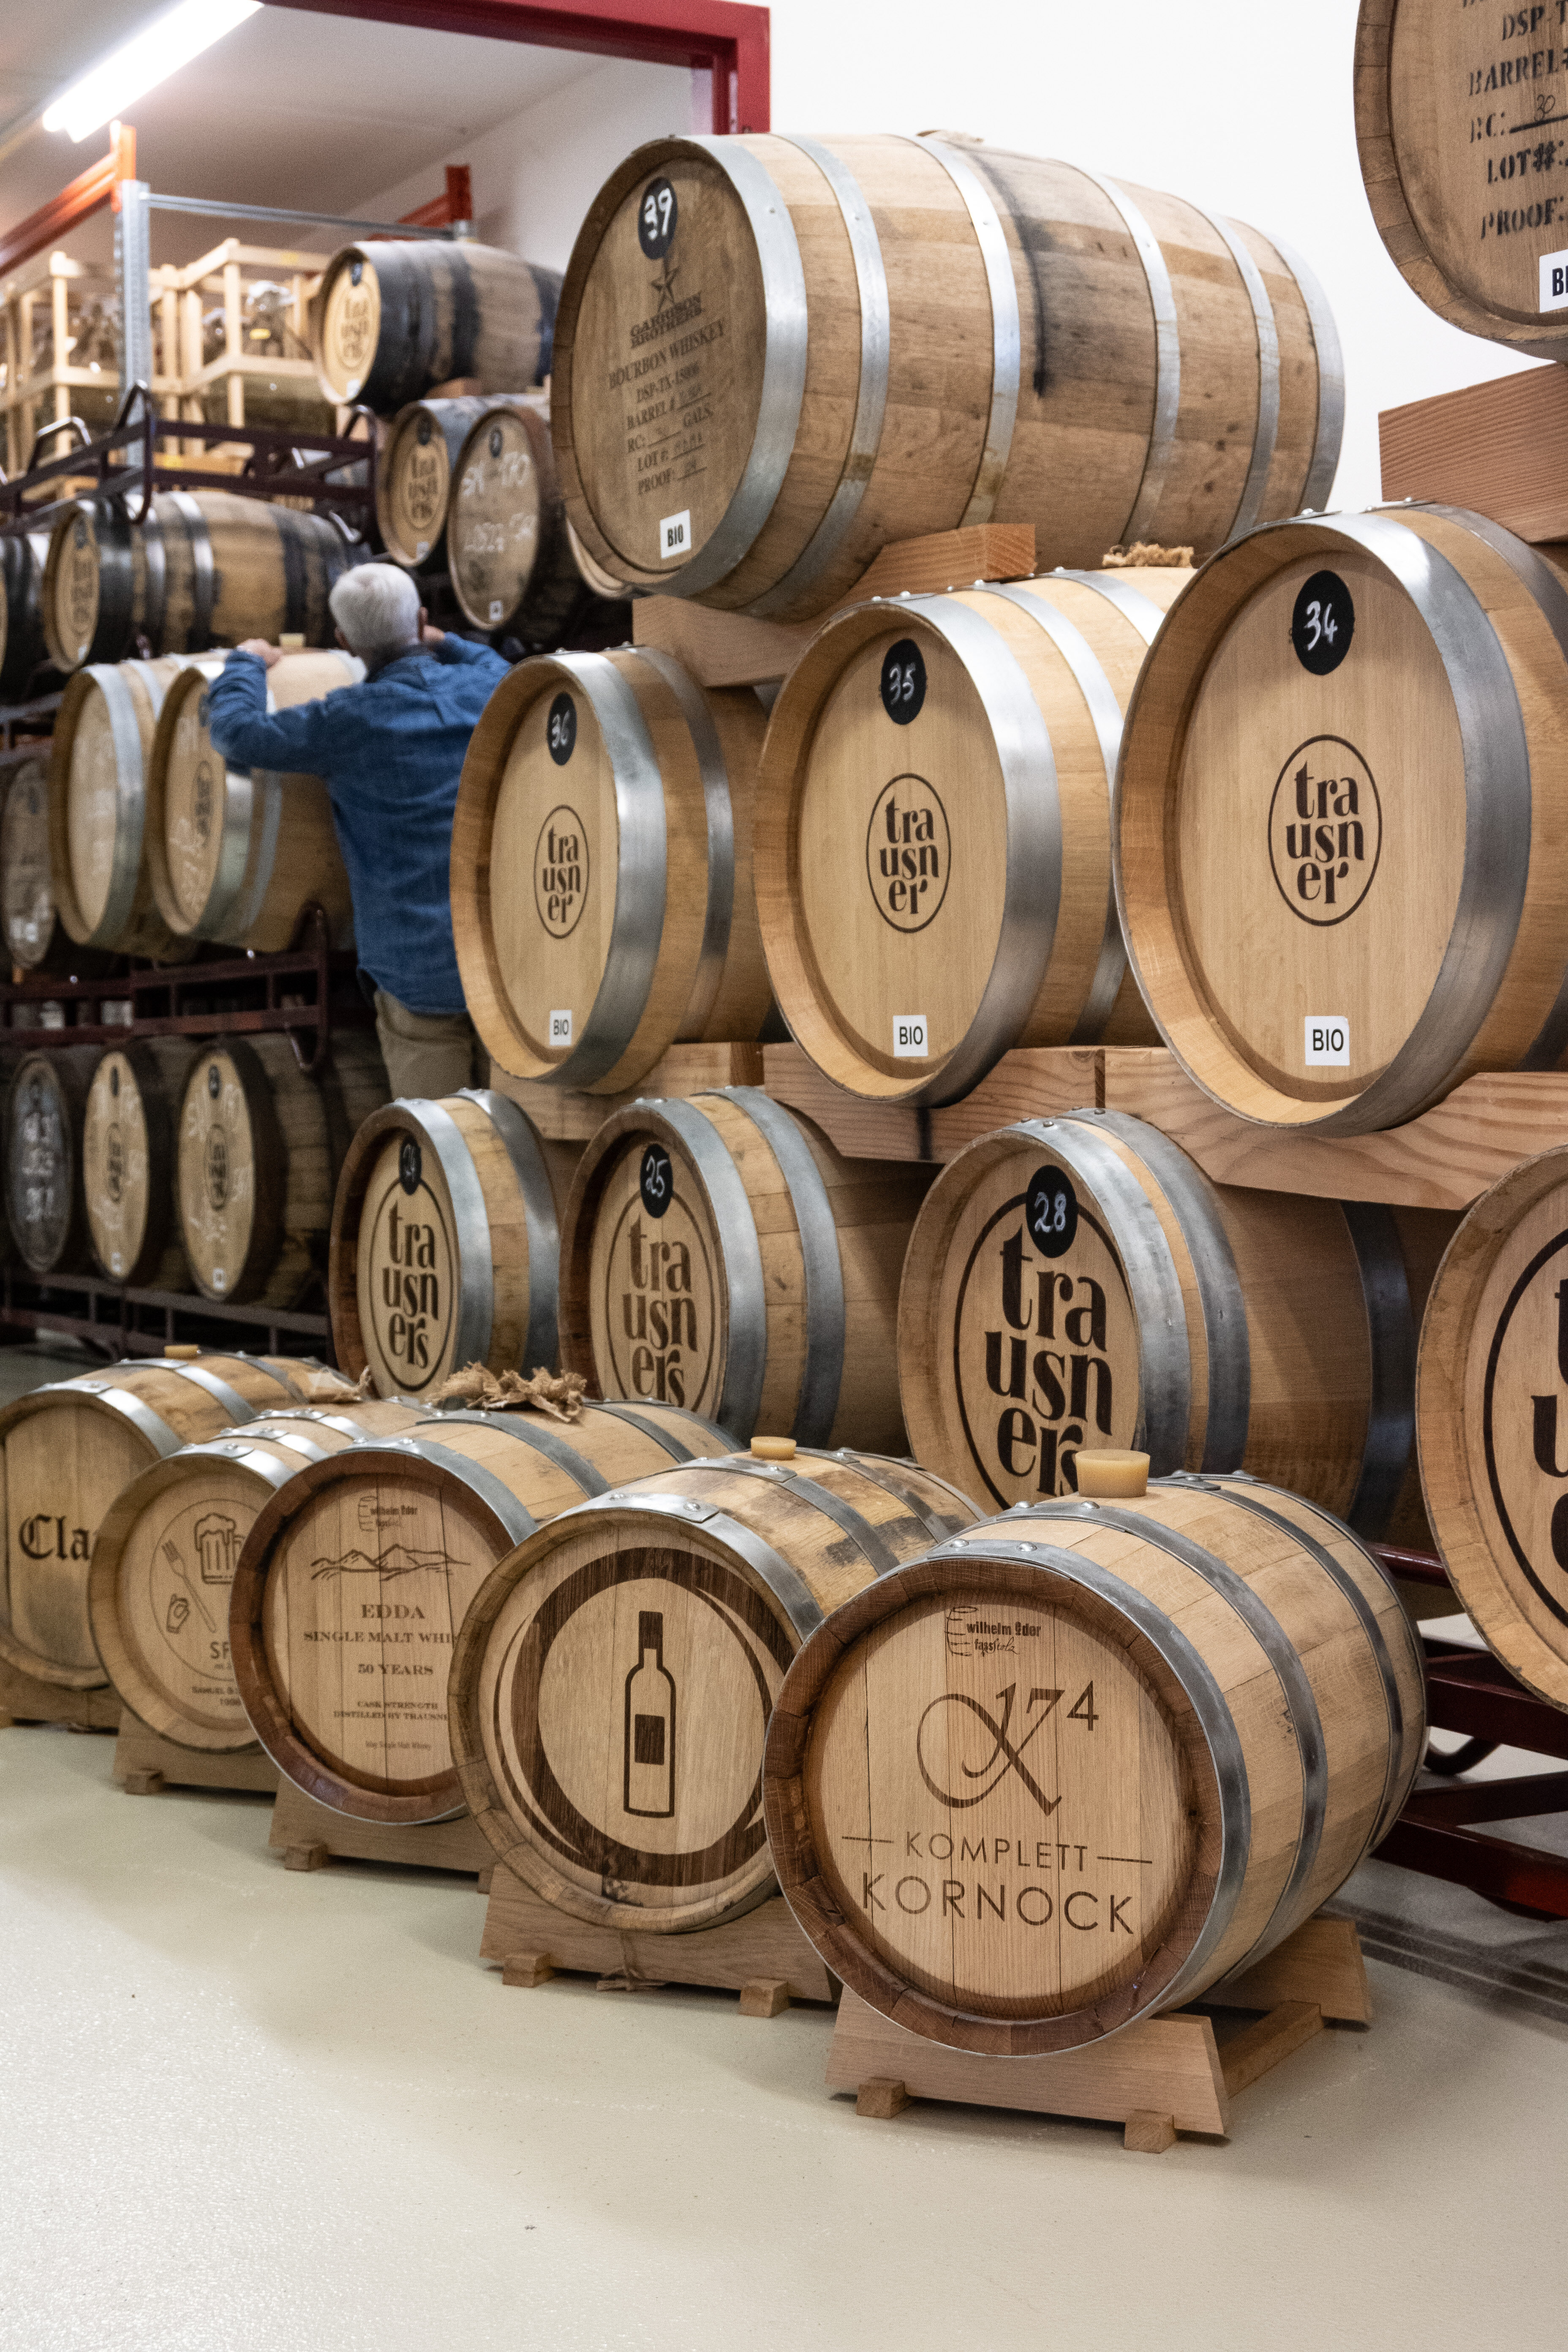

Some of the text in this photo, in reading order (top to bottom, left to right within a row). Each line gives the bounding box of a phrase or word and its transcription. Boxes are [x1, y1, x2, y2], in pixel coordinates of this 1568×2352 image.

[667, 523, 684, 547] BIO
[1305, 600, 1339, 651] 34
[889, 662, 917, 705] 35
[552, 710, 570, 749] 36
[1294, 760, 1360, 819] tra
[884, 795, 934, 844] tra
[547, 823, 579, 864] tra
[879, 844, 939, 879] usn
[1285, 819, 1365, 864] usn
[542, 862, 581, 894] usn
[888, 879, 928, 915] er
[1296, 860, 1349, 904] er
[547, 893, 572, 923] er
[553, 1018, 569, 1035] BIO
[898, 1025, 923, 1045] BIO
[1312, 1028, 1345, 1053] BIO
[1034, 1192, 1067, 1233] 28
[388, 1200, 435, 1269] tra
[628, 1212, 692, 1293] tra
[383, 1266, 439, 1320] usn
[999, 1223, 1108, 1352] tra
[622, 1292, 698, 1352] usn
[984, 1330, 1113, 1436] usn
[361, 1604, 425, 1619] EDDA
[966, 1621, 1012, 1636] wilhelm
[304, 1631, 364, 1642] SINGLE
[368, 1632, 413, 1643] MALT
[378, 1664, 434, 1675] YEARS
[906, 1831, 1088, 1872] KOMPLETT
[862, 1872, 1134, 1935] KORNOCK
